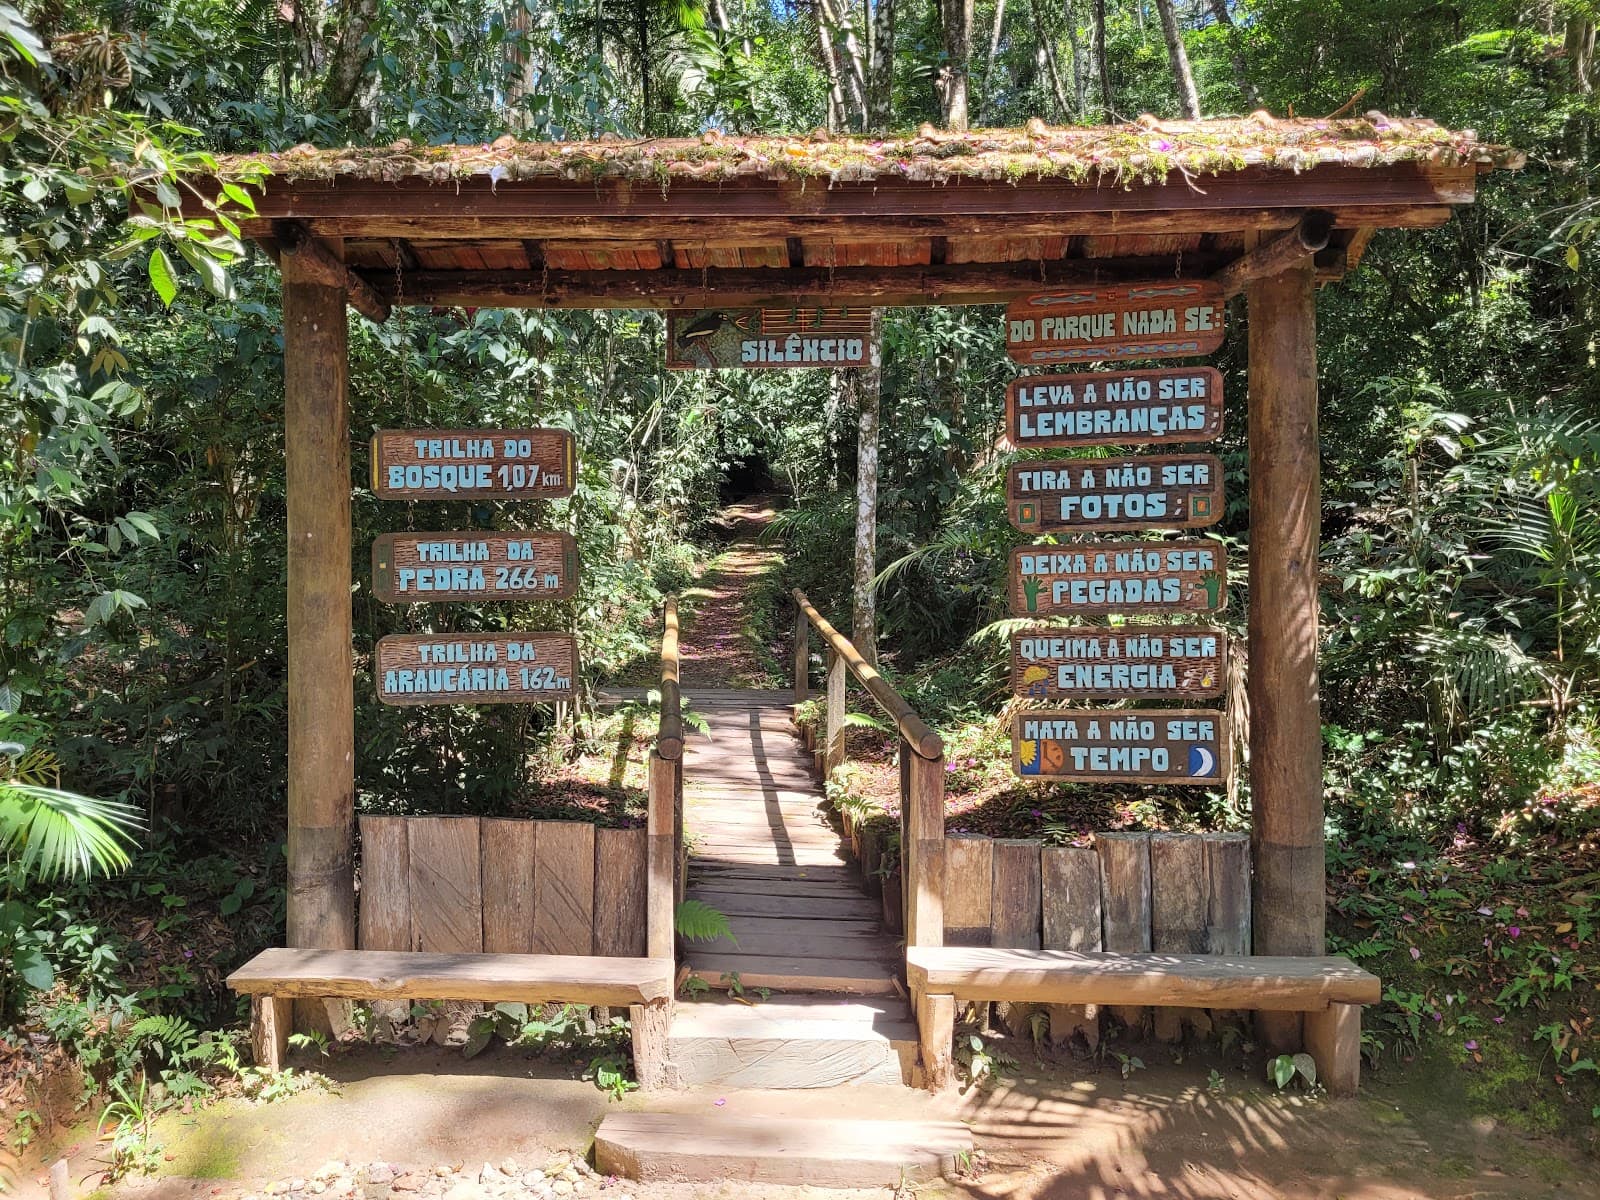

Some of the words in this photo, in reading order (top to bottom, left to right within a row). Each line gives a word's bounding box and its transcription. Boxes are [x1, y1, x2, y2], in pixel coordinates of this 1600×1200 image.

[1010, 320, 1034, 342] DO
[1042, 313, 1115, 341] PARQUE
[1123, 309, 1176, 335] NADA
[1185, 307, 1220, 331] SE:
[741, 333, 863, 362] SILÊNCIO
[1019, 385, 1074, 406] LEVA
[1084, 384, 1097, 403] A
[1106, 377, 1150, 402] NÃO
[1158, 378, 1205, 399] SER
[415, 439, 494, 458] TRILHA
[504, 439, 531, 457] DO
[389, 465, 493, 492] BOSQUE
[542, 472, 561, 486] km
[1018, 470, 1070, 491] TIRA
[1082, 469, 1095, 488] A
[1105, 463, 1150, 487] NÃO
[1162, 465, 1208, 485] SER
[417, 542, 489, 561] TRILHA
[508, 542, 533, 560] DA
[1020, 554, 1087, 574] DEIXA
[1094, 554, 1107, 573] A
[1115, 548, 1160, 572] NÃO
[1167, 551, 1213, 571] SER
[400, 568, 485, 591] PEDRA
[496, 567, 537, 590] 266
[544, 574, 559, 589] m
[418, 643, 497, 663] TRILHA
[507, 643, 535, 661] DA
[1020, 639, 1100, 661] QUEIMA
[1108, 639, 1119, 657] A
[1125, 634, 1163, 657] NÃO
[1170, 637, 1216, 657] SER
[384, 664, 509, 693] ARAUCÁRIA
[1025, 720, 1078, 740] MATA
[1088, 720, 1100, 740] A
[1110, 716, 1155, 740] NÃO
[1167, 720, 1214, 741] SER
